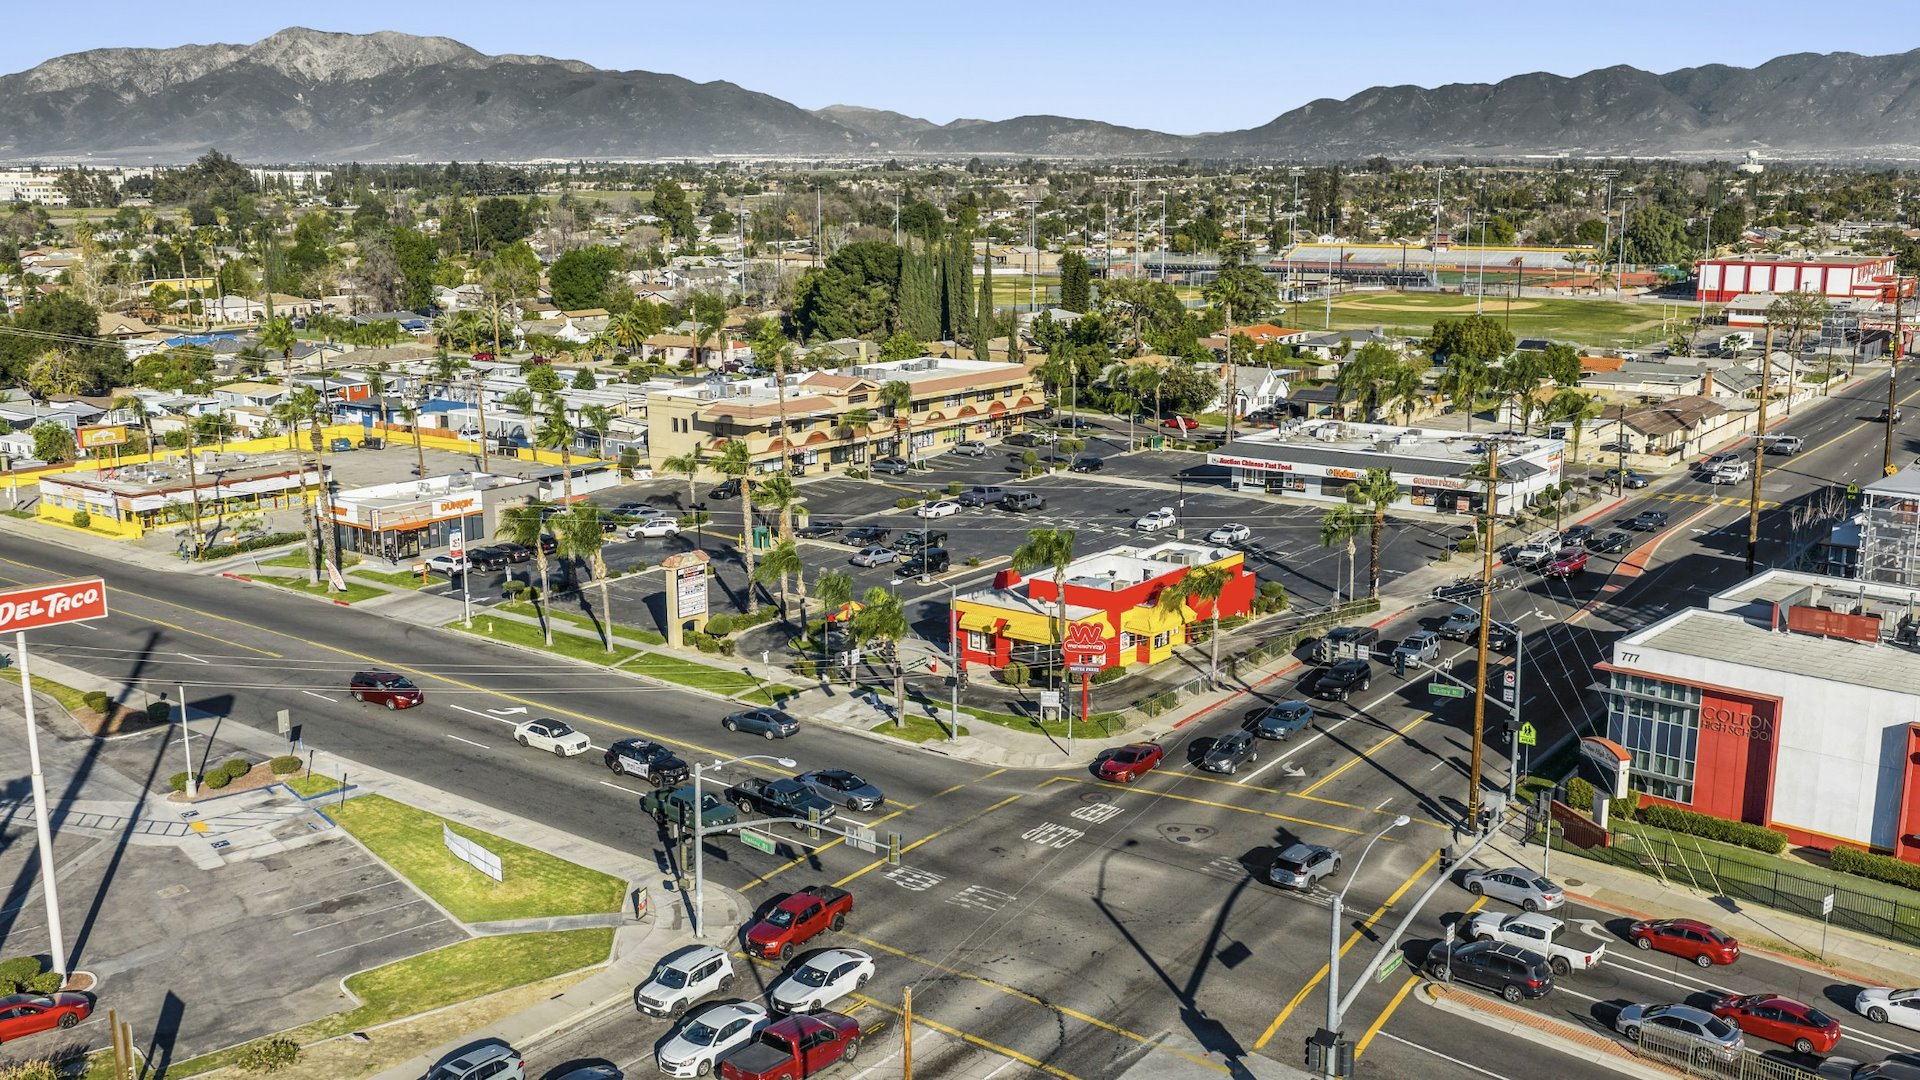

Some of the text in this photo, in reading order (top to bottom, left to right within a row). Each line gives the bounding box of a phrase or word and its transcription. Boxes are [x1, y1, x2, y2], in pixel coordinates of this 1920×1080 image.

[1219, 457, 1241, 466] Auction
[1242, 460, 1264, 468] Chinese
[1413, 477, 1438, 486] GOLDEN
[1621, 651, 1641, 663] 777
[1702, 705, 1774, 730] COLTON
[1700, 719, 1772, 742] HIGH SCHOOL
[1021, 821, 1086, 849] CLEAR
